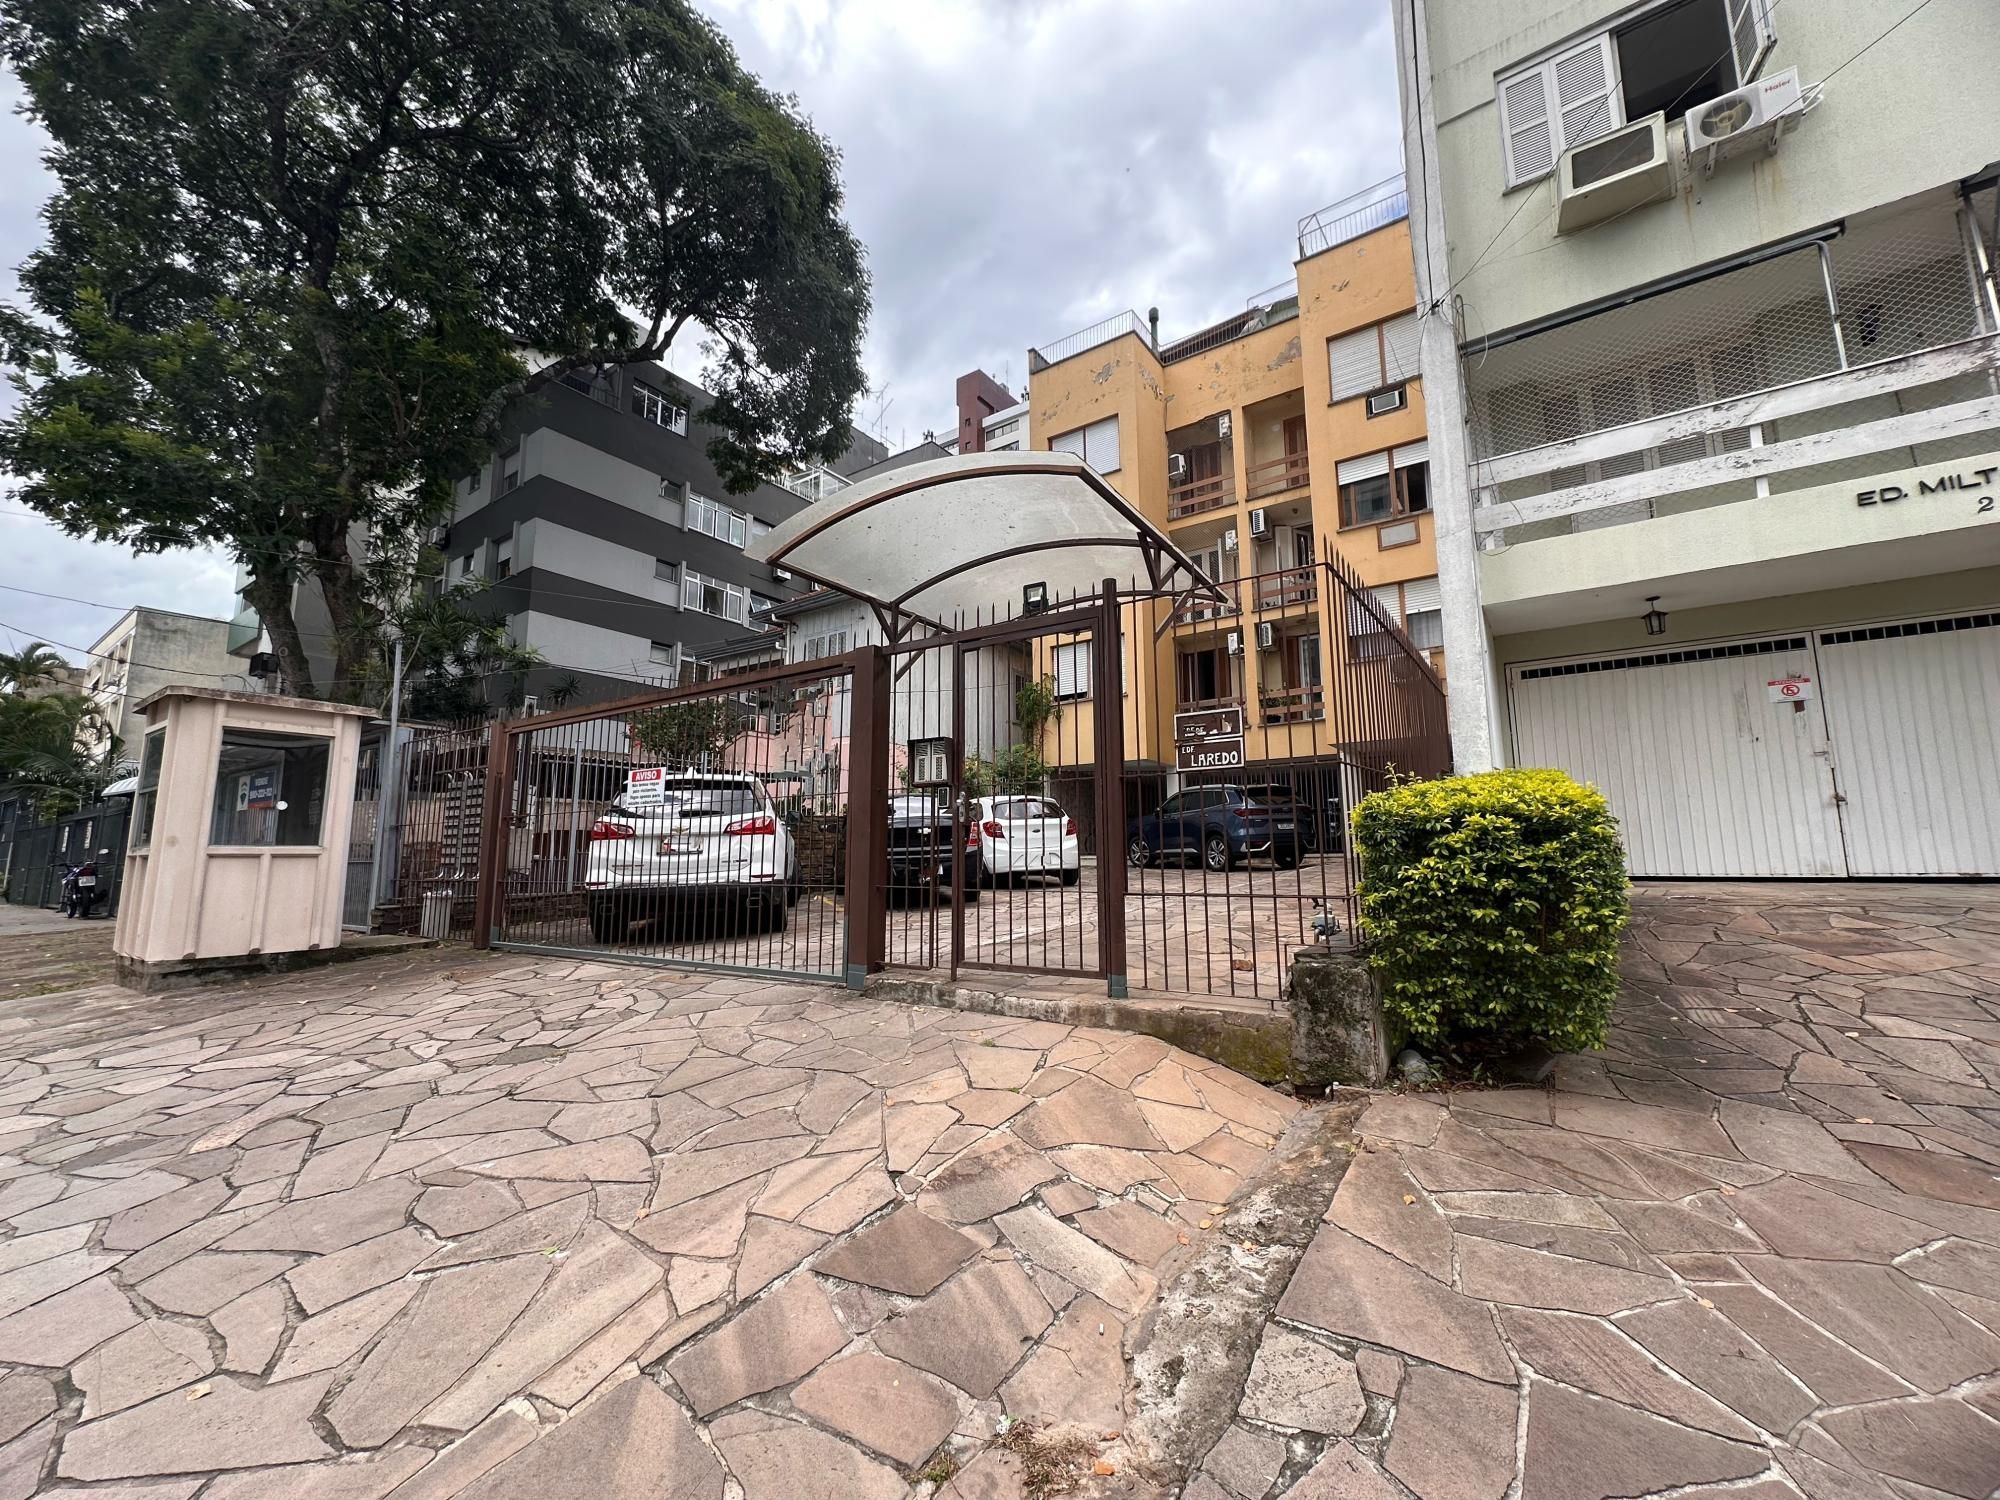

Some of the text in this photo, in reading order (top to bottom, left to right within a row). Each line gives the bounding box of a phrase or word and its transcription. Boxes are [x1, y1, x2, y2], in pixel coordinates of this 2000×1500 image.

[1764, 79, 1791, 93] Haier
[1856, 466, 1998, 507] ED. MILT
[1191, 750, 1239, 767] LAREDO
[635, 770, 658, 781] AVISO
